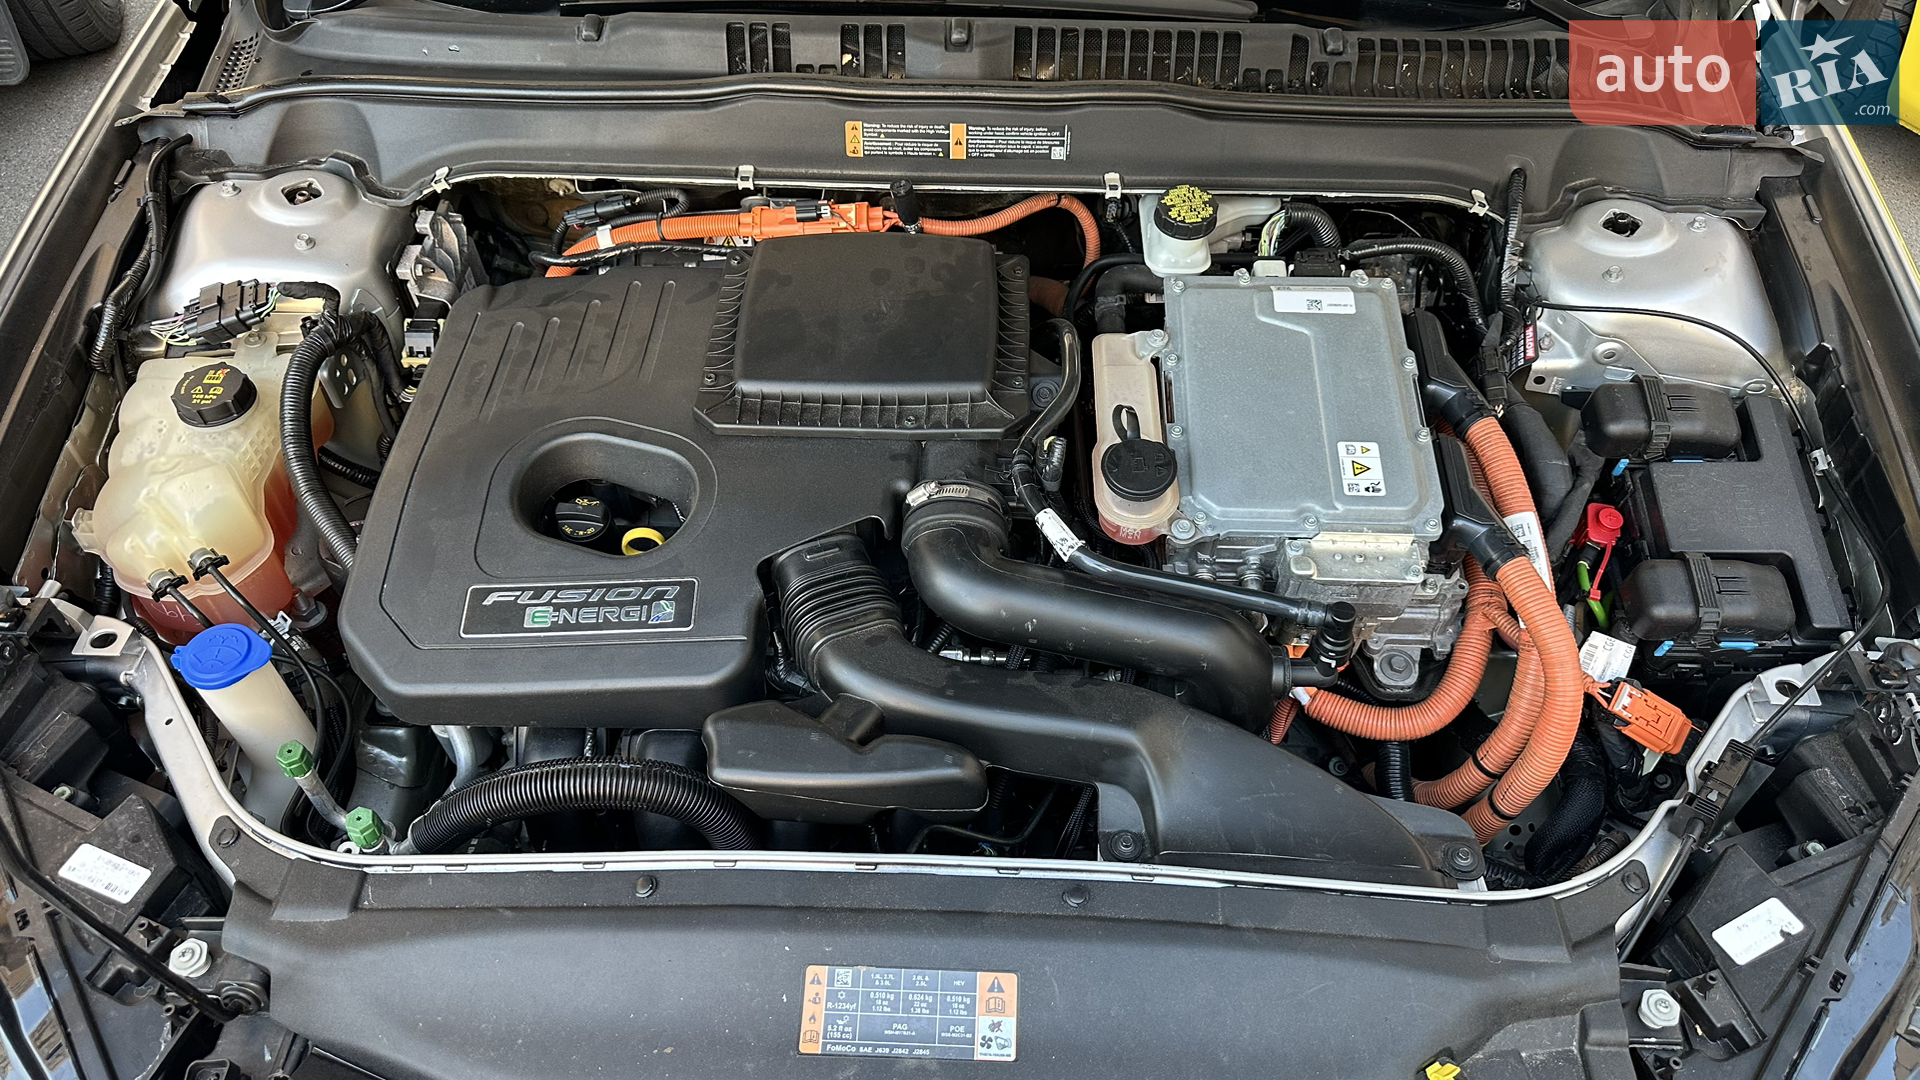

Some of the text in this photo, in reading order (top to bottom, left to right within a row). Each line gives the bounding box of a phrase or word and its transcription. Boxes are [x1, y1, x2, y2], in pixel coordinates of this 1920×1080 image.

[1526, 326, 1535, 357] MOTUL
[482, 586, 679, 605] FUSION
[527, 604, 648, 626] ENERGI
[1603, 638, 1616, 651] CGE
[1623, 645, 1634, 658] CGE
